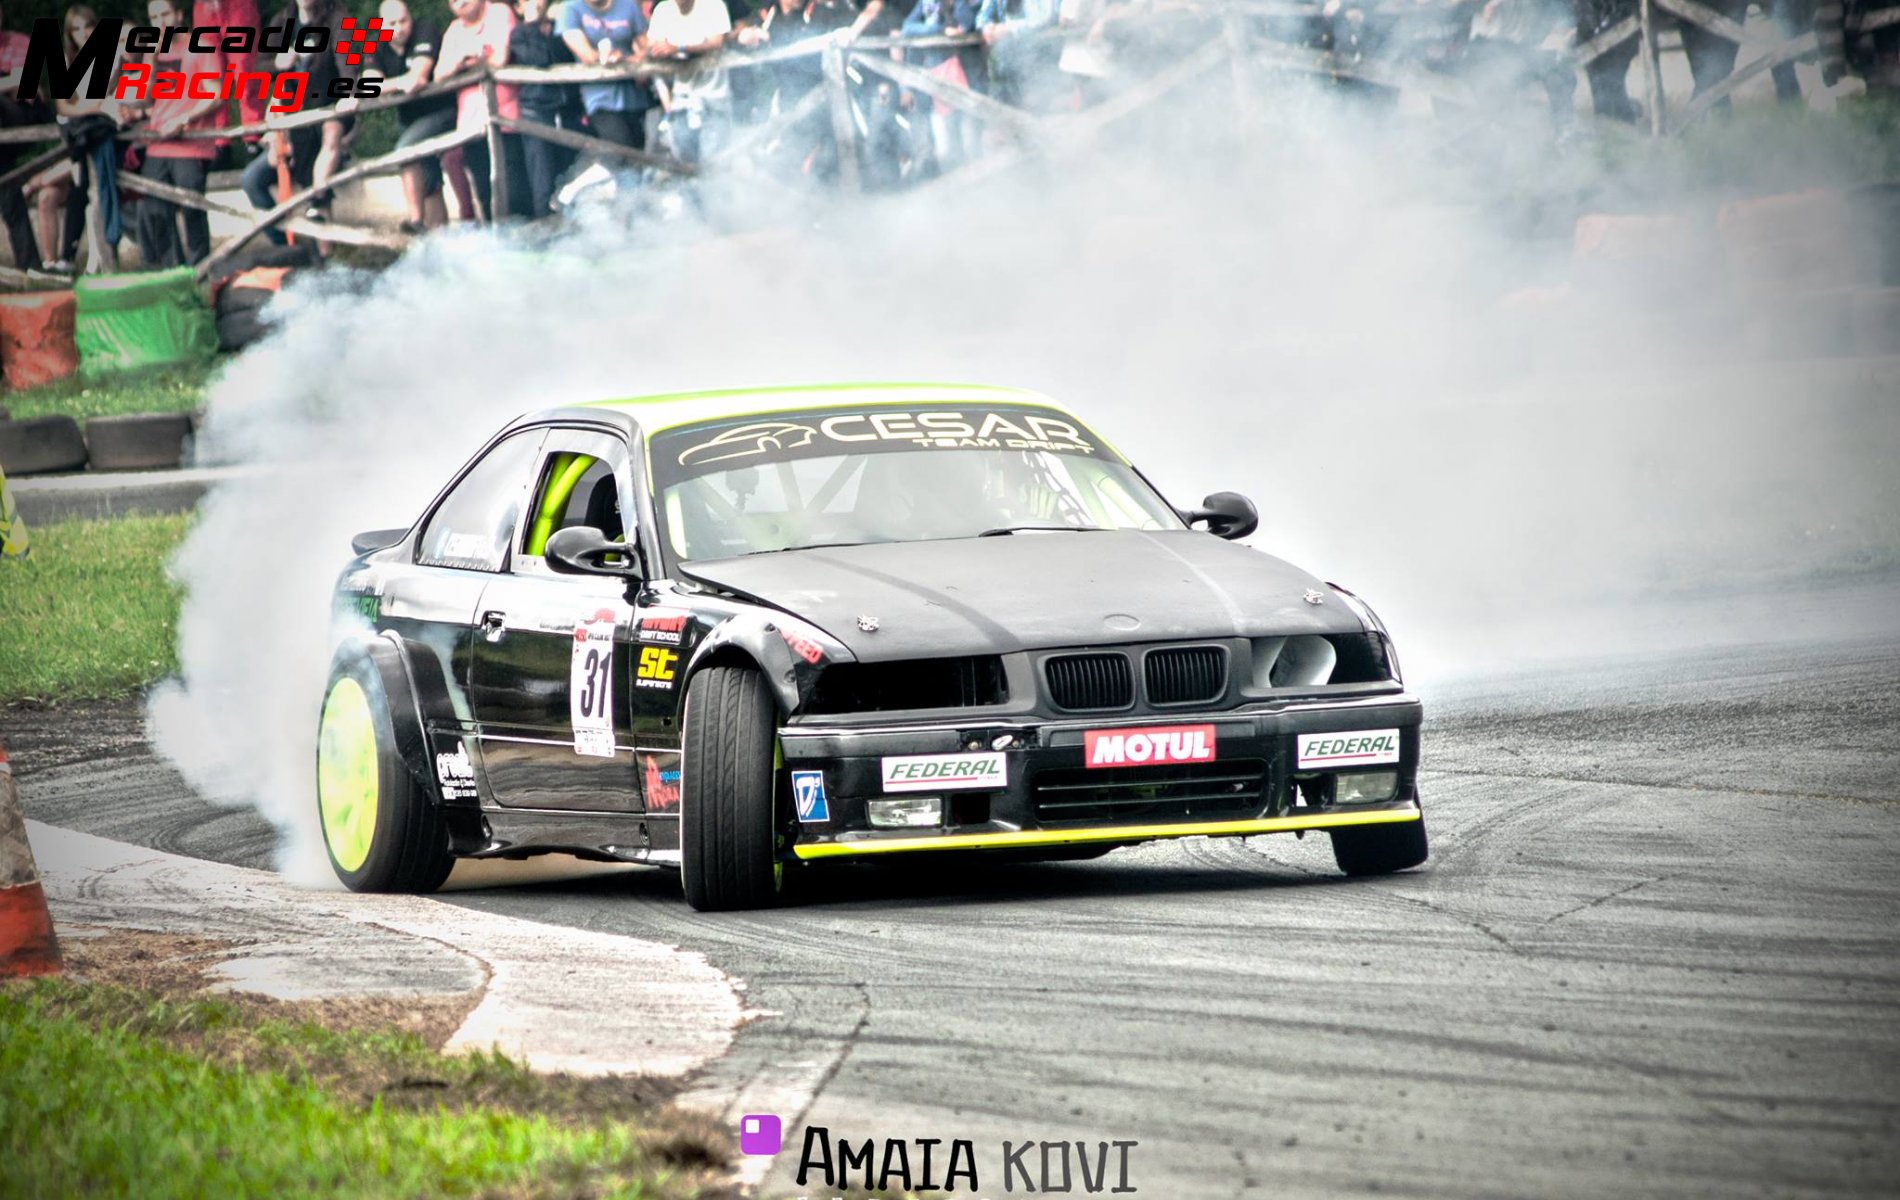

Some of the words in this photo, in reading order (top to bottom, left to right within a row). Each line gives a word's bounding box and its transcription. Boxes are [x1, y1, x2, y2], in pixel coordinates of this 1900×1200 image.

[820, 412, 1092, 445] CESAR
[912, 438, 1001, 448] TEAM
[1005, 440, 1096, 454] DRIFT
[580, 648, 611, 718] 31
[1092, 730, 1211, 765] MOTUL
[1304, 735, 1395, 756] FEDERAL
[889, 759, 1001, 779] FEDERAL
